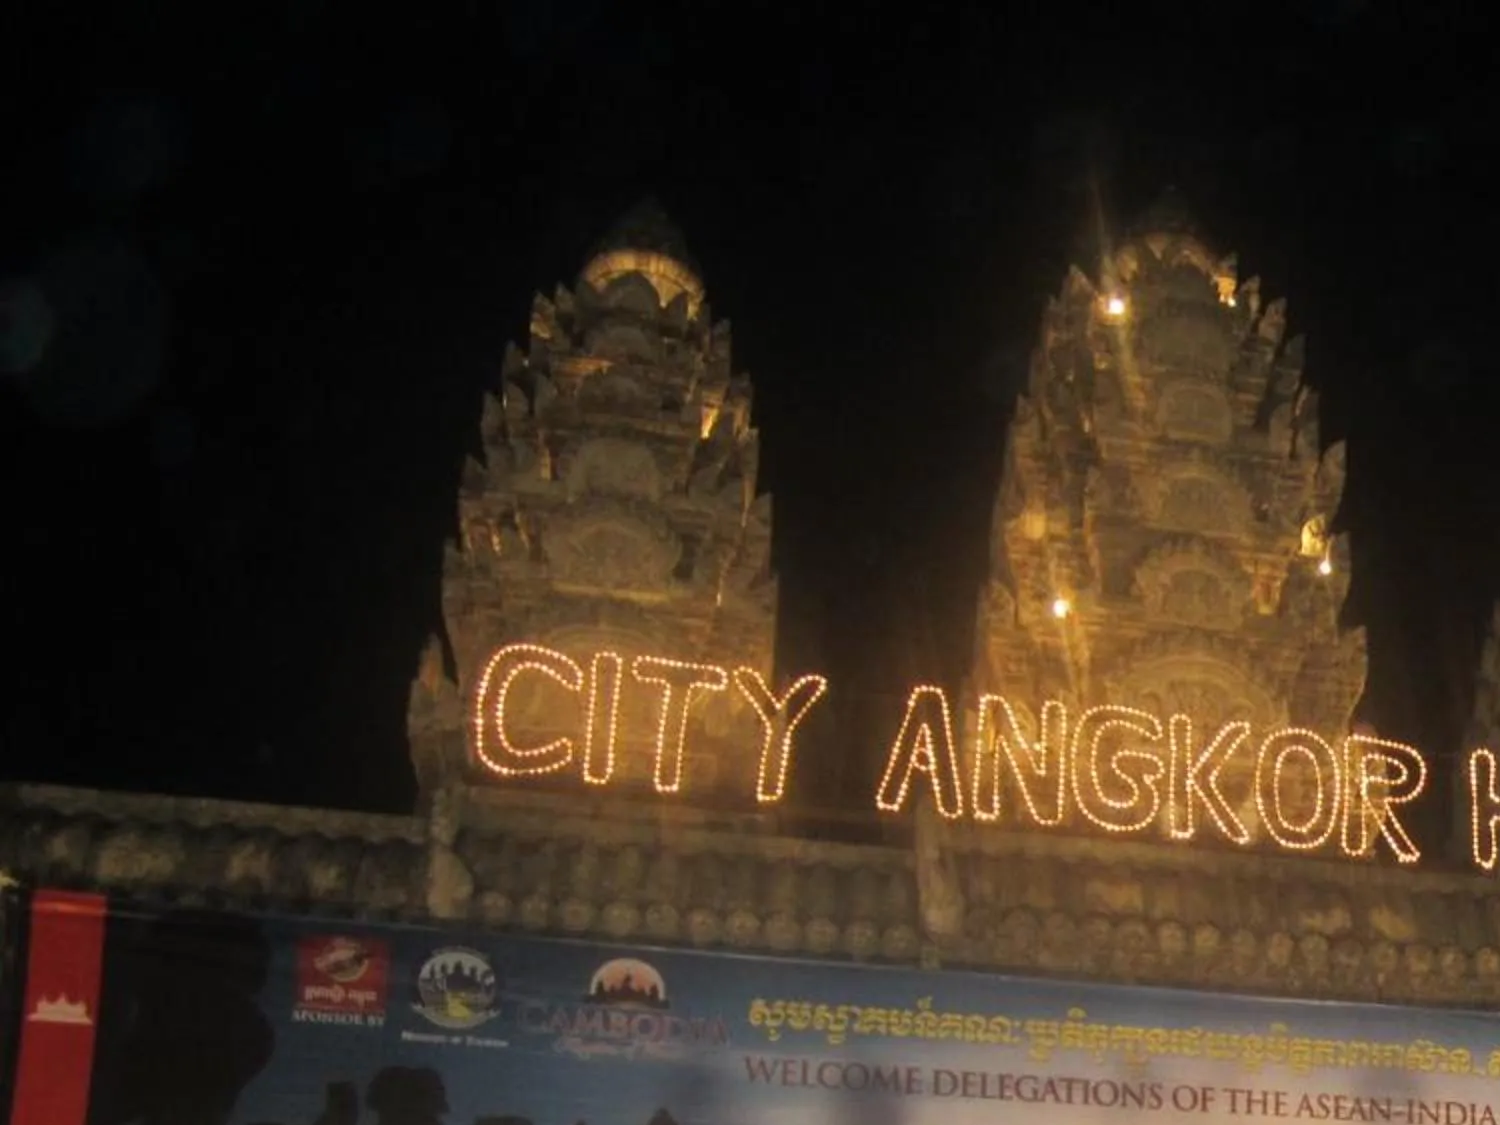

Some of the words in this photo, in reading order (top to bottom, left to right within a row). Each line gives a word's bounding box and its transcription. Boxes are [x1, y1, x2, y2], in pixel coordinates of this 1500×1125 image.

[476, 644, 827, 802] CITY
[876, 684, 1427, 864] ANGKOR
[744, 1055, 922, 1096] WELCOME
[932, 1068, 1164, 1111] DELEGATIONS
[1172, 1084, 1216, 1113] OF
[1223, 1087, 1289, 1117] THE
